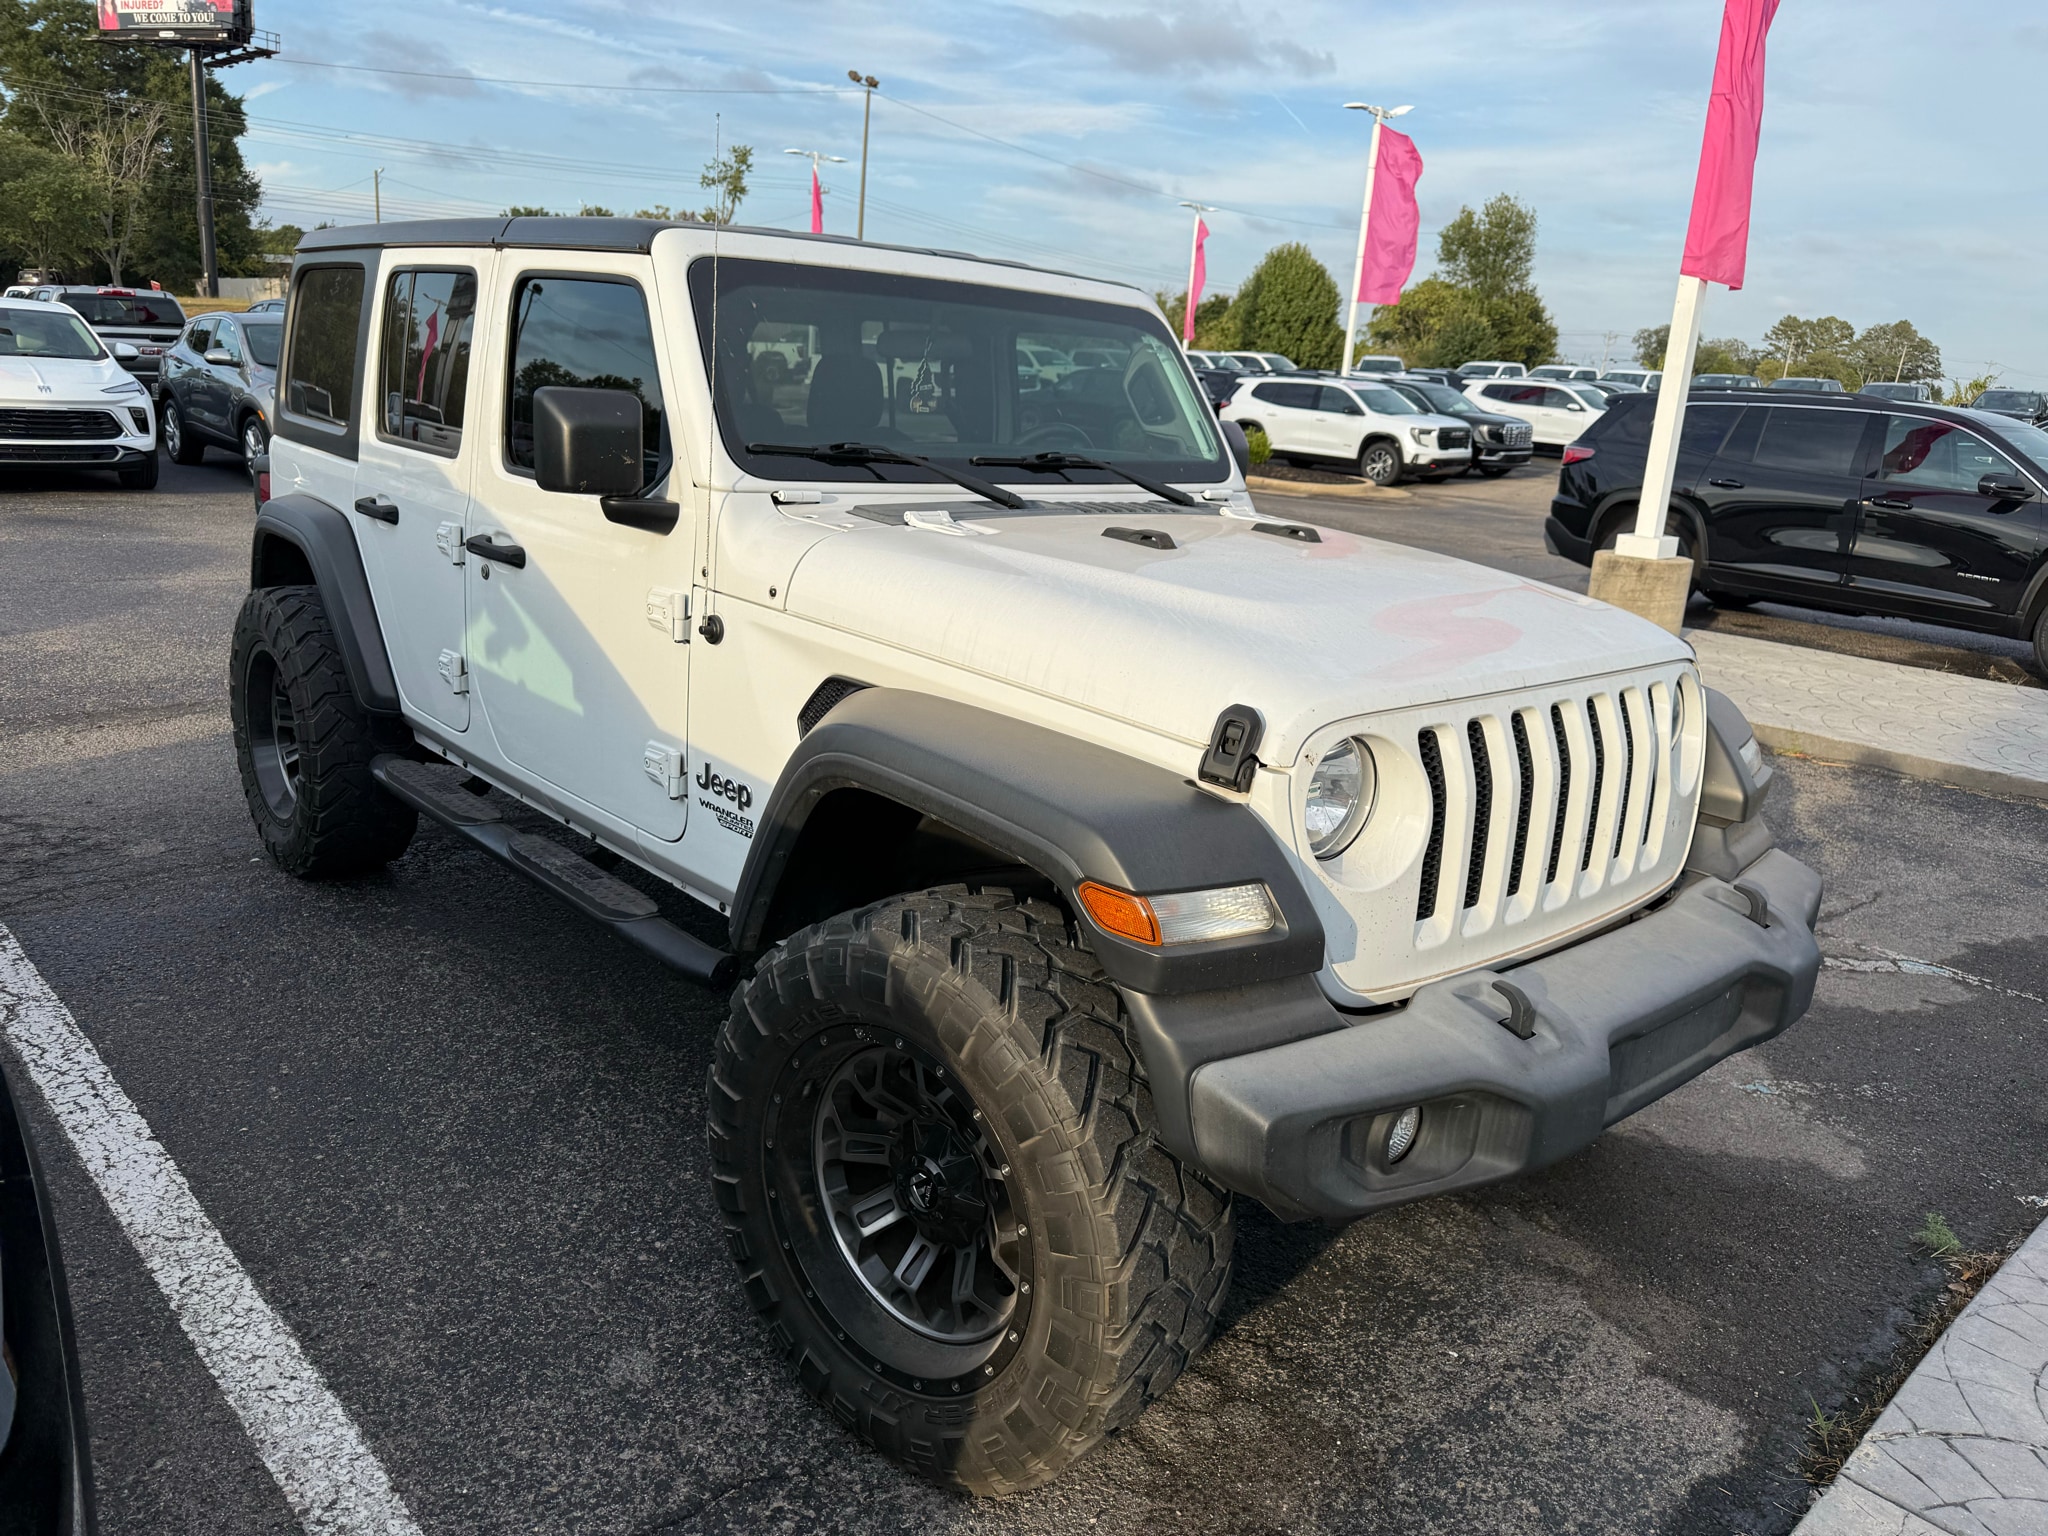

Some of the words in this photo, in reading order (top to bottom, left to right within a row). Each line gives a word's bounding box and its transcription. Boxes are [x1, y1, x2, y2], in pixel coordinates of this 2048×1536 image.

[120, 0, 164, 10] INJURED?
[133, 12, 149, 23] WE
[149, 12, 177, 23] COME
[178, 12, 190, 23] TO
[191, 12, 215, 23] YOU!
[696, 760, 753, 812] Jeep
[699, 797, 754, 828] WRANGLER
